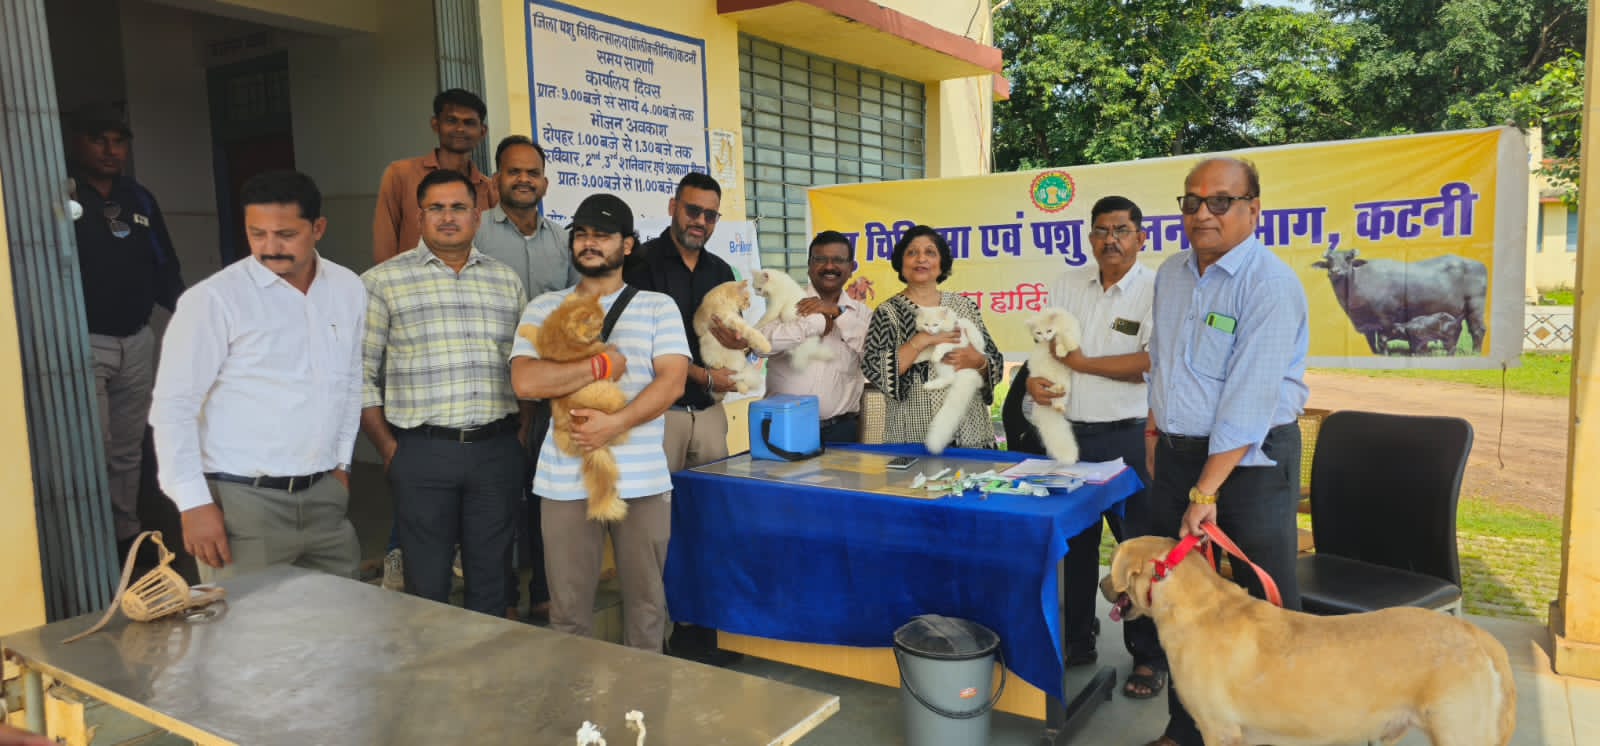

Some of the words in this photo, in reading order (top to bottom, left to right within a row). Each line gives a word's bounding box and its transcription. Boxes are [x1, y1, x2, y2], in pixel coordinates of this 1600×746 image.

[532, 11, 557, 33] जिला
[559, 20, 577, 42] पशु
[597, 49, 623, 69] समय
[624, 56, 654, 75] सारणी
[585, 69, 630, 92] कार्यालय
[633, 77, 662, 99] दिवस
[604, 92, 617, 109] से
[618, 96, 640, 112] सायं
[679, 108, 695, 121] तक
[590, 109, 624, 131] भोजन
[626, 118, 669, 138] अवकाश
[542, 122, 574, 146] दोपहर
[622, 133, 633, 152] से
[675, 145, 693, 159] तक
[618, 154, 653, 174] शनिवार
[653, 158, 665, 176] एवं
[665, 161, 689, 177] अवकाश
[622, 174, 634, 191] से
[978, 211, 1024, 257] एवं
[1030, 219, 1088, 267] पशु
[1354, 182, 1479, 242] कटनी
[989, 282, 1049, 314] हार्दि
